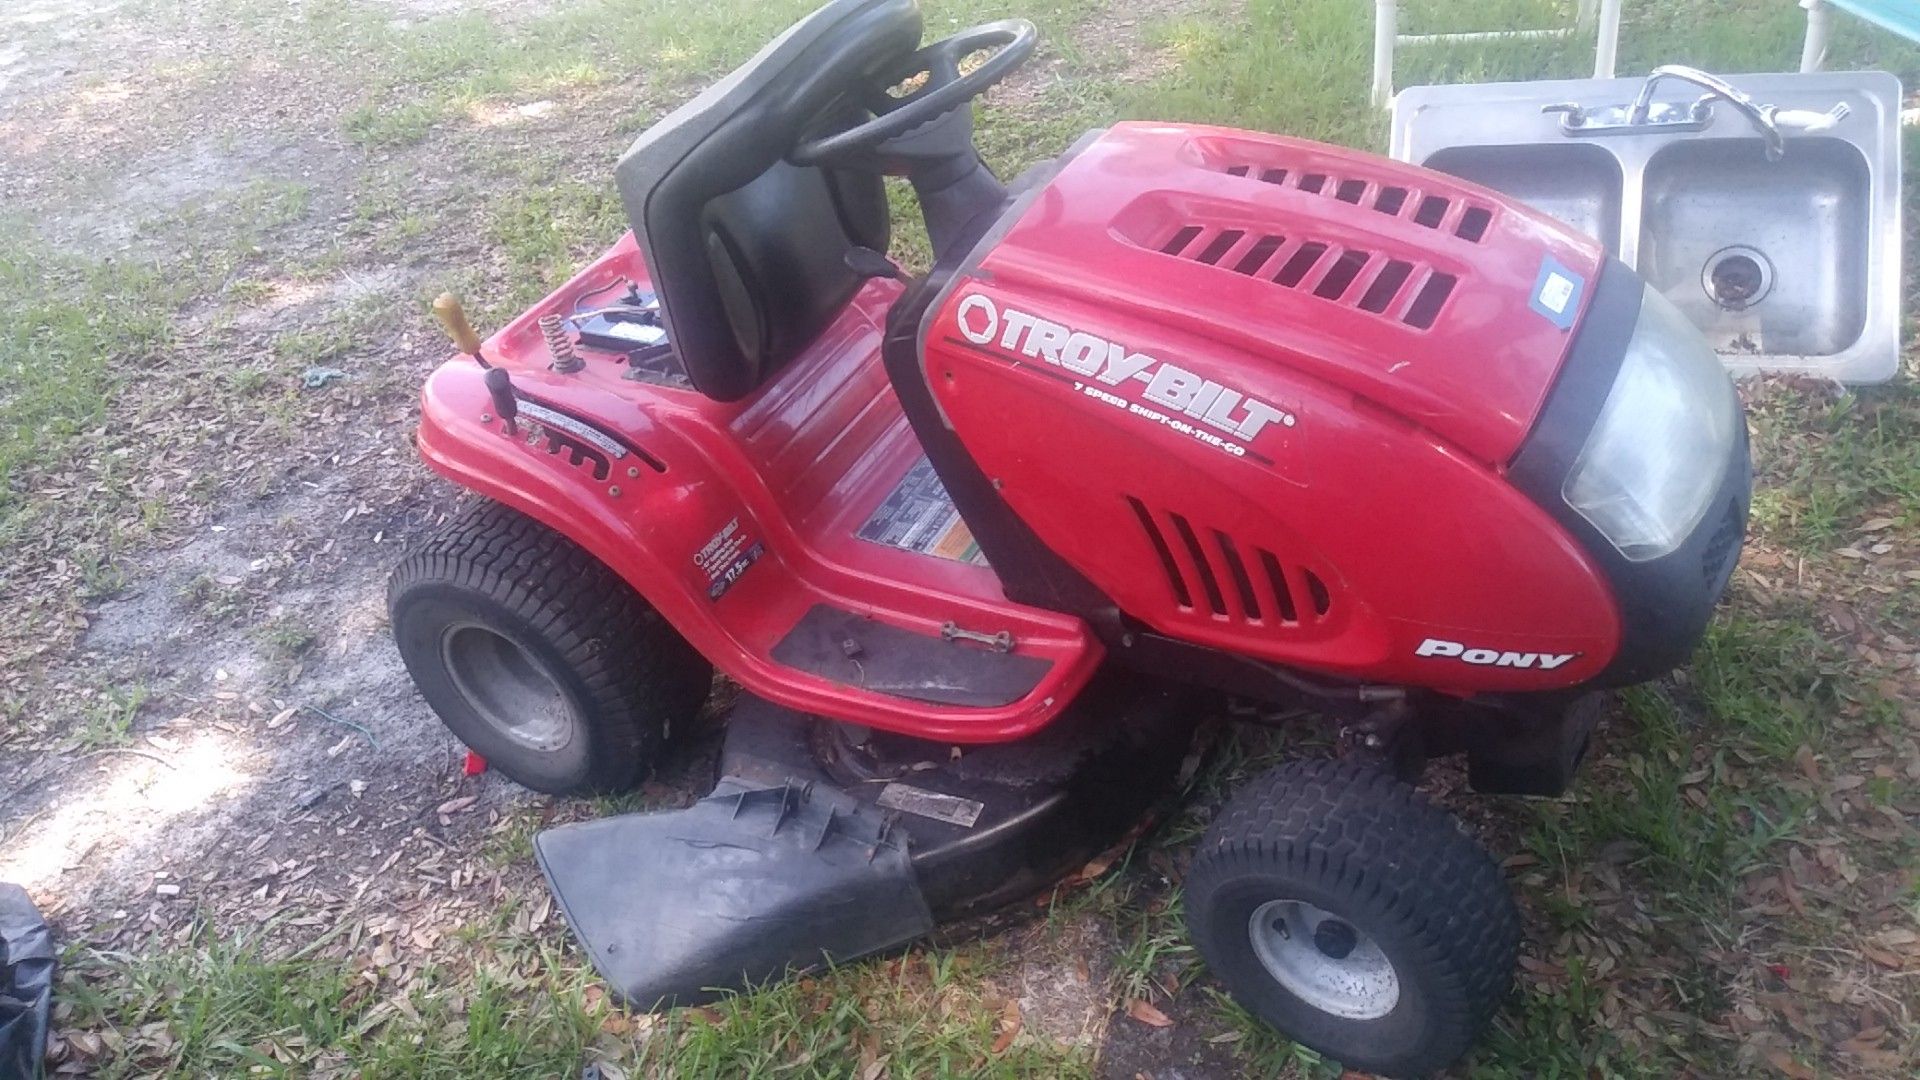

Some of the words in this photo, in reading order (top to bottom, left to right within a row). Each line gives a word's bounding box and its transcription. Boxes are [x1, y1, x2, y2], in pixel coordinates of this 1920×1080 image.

[1073, 381, 1083, 392] 7
[1084, 385, 1129, 410] SPEED
[1129, 402, 1246, 457] SHIFT-ON-THE-GO
[1414, 638, 1575, 670] PONY
